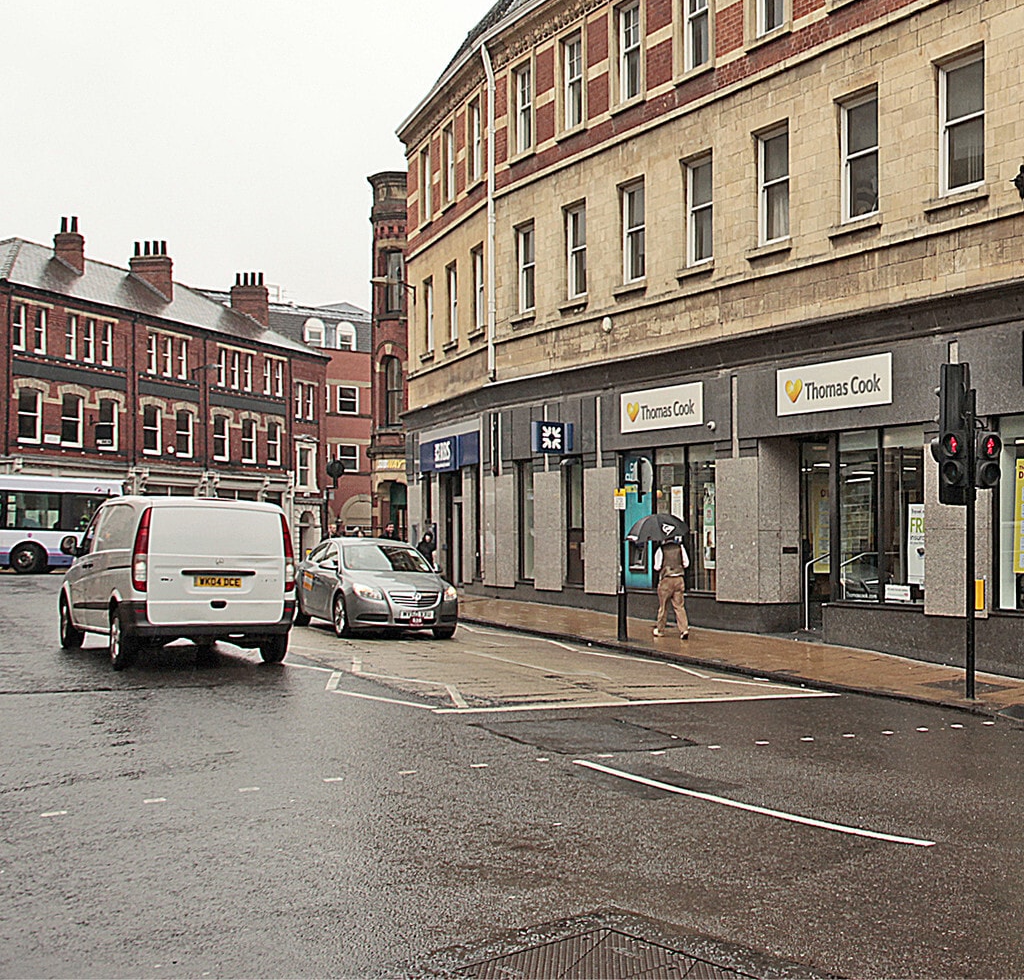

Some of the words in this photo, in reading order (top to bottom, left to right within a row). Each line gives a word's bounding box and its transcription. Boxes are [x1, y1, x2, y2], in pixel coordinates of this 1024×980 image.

[804, 381, 848, 400] Thomas
[850, 373, 881, 395] Cook
[640, 404, 672, 421] Thomas
[673, 398, 695, 417] Cook
[223, 577, 241, 587] DCE
